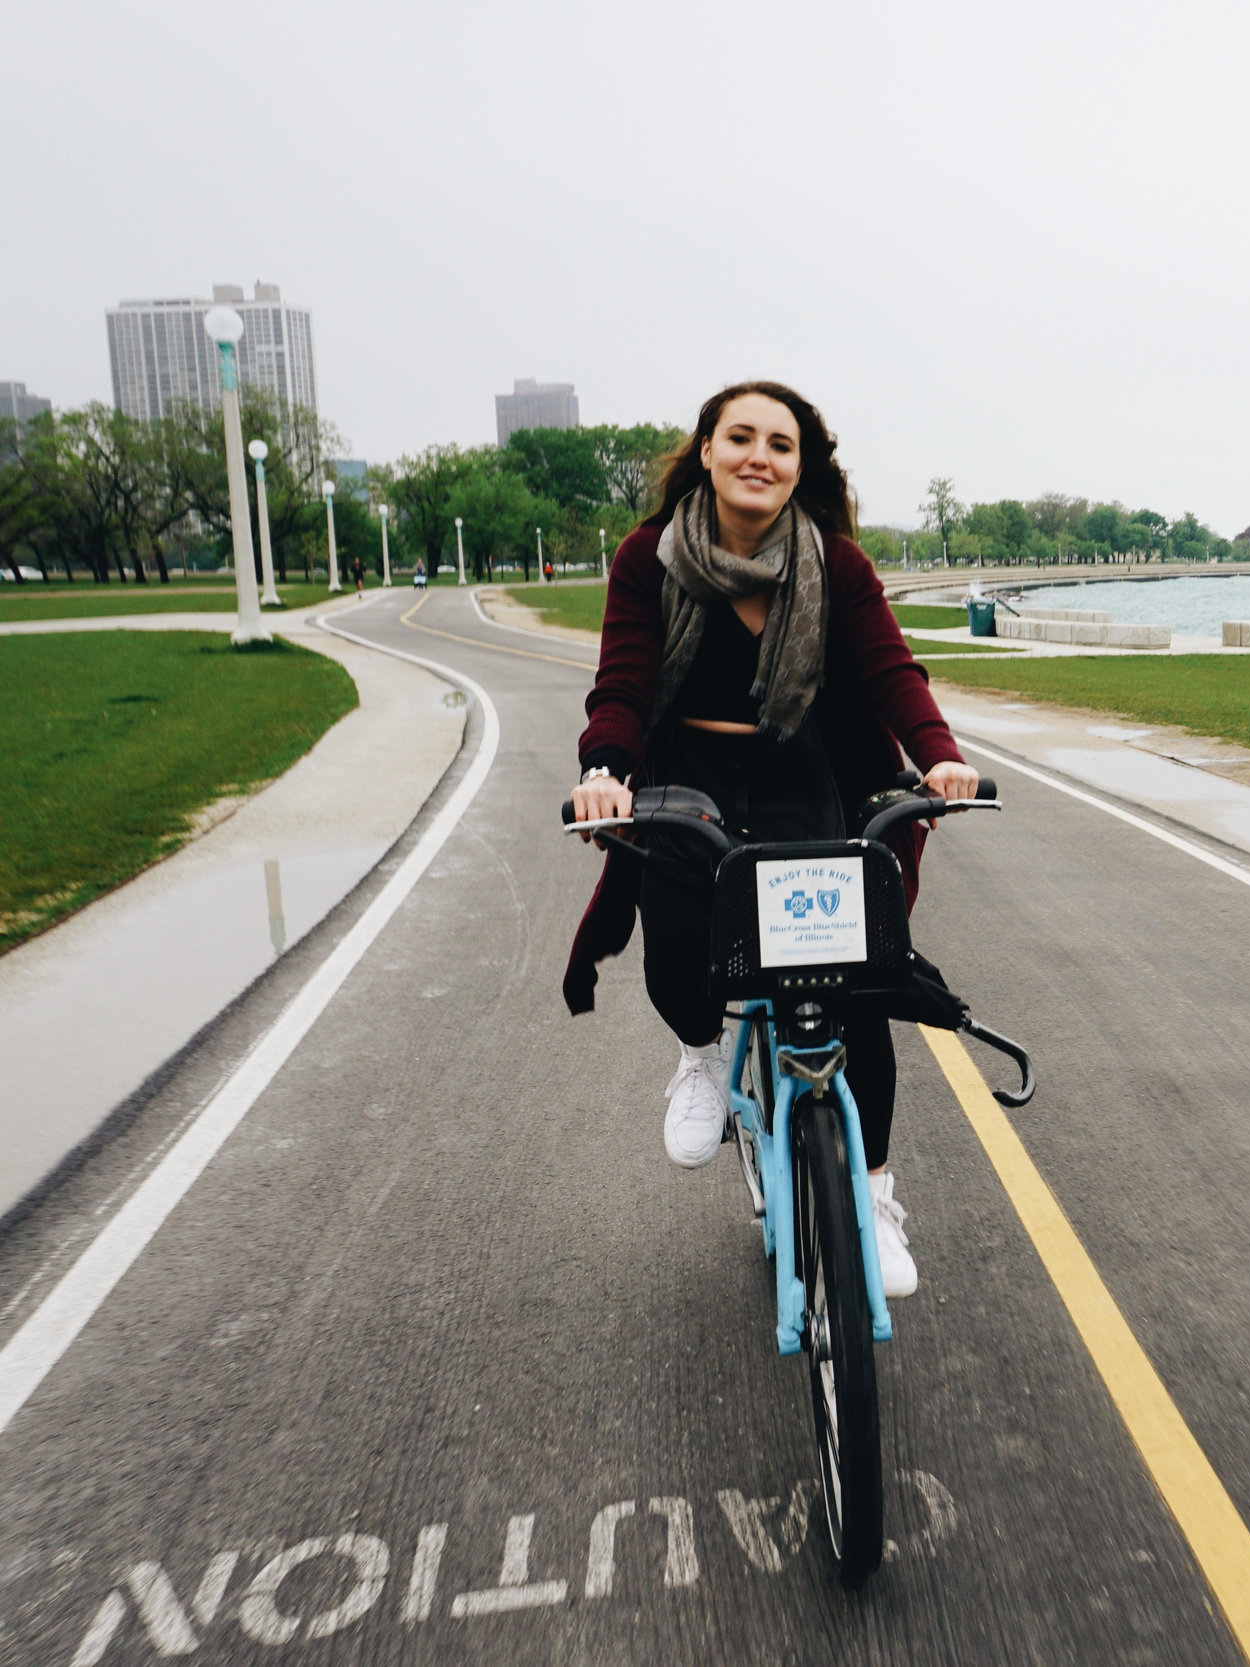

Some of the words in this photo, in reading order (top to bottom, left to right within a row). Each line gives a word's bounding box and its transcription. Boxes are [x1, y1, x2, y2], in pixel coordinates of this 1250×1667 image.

[768, 870, 801, 888] ENJOY
[806, 868, 824, 877] THE
[829, 869, 853, 884] RIDE
[769, 924, 811, 934] BlueCross
[813, 921, 857, 931] BlueShield
[794, 934, 803, 942] of
[805, 933, 833, 941] Illinois
